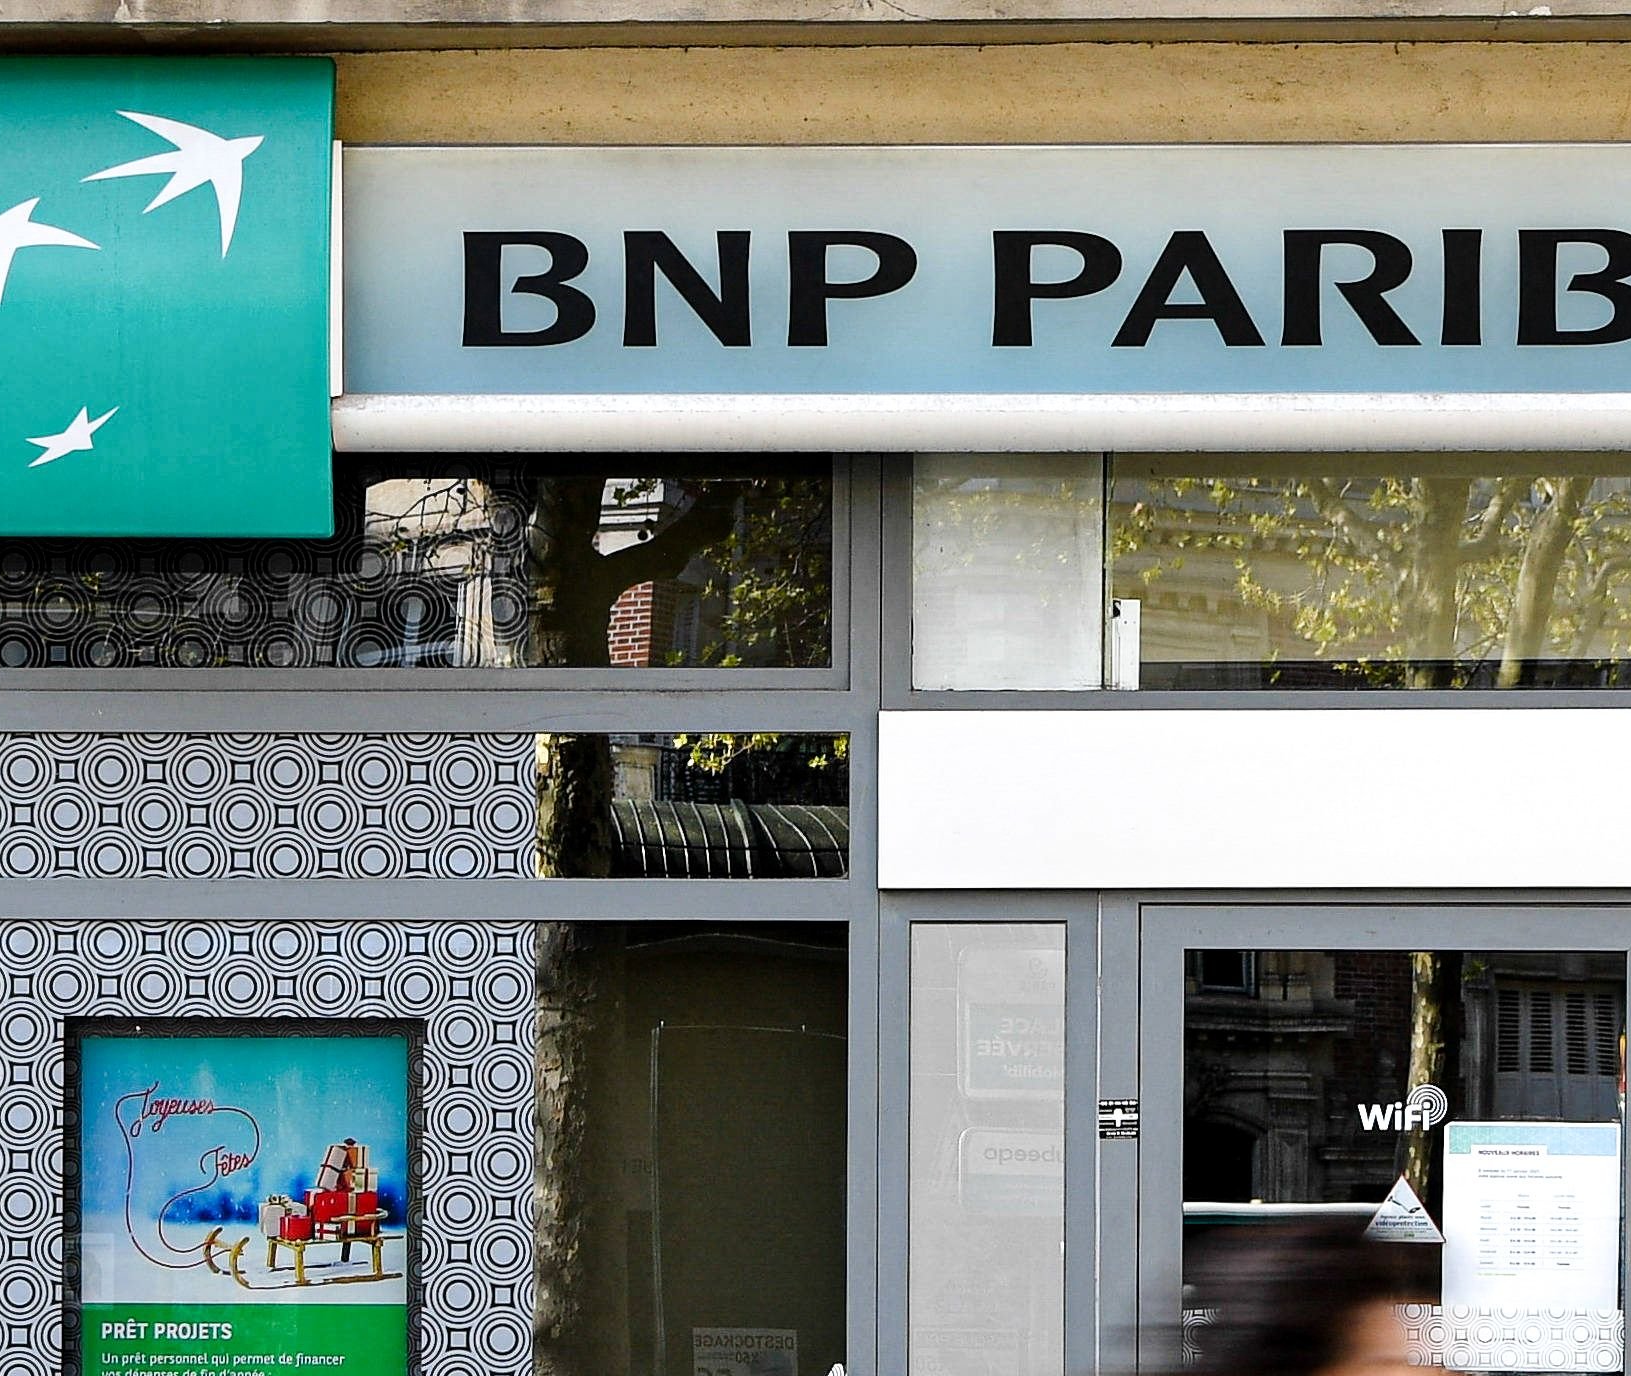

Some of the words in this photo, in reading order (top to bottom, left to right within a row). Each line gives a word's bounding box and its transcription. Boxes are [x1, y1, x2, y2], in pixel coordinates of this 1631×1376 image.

[461, 229, 919, 348] BNP
[128, 1081, 214, 1137] Joyeuses
[1357, 1101, 1431, 1131] WiFi
[200, 1146, 253, 1185] Fêtes
[101, 1319, 147, 1340] PRÊT
[153, 1323, 233, 1340] PROJETS
[101, 1353, 119, 1365] Un
[122, 1353, 146, 1367] prêt
[149, 1353, 208, 1368] personnel
[211, 1354, 230, 1368] qui
[233, 1355, 275, 1367] permet
[279, 1354, 293, 1365] de
[295, 1355, 345, 1368] financer
